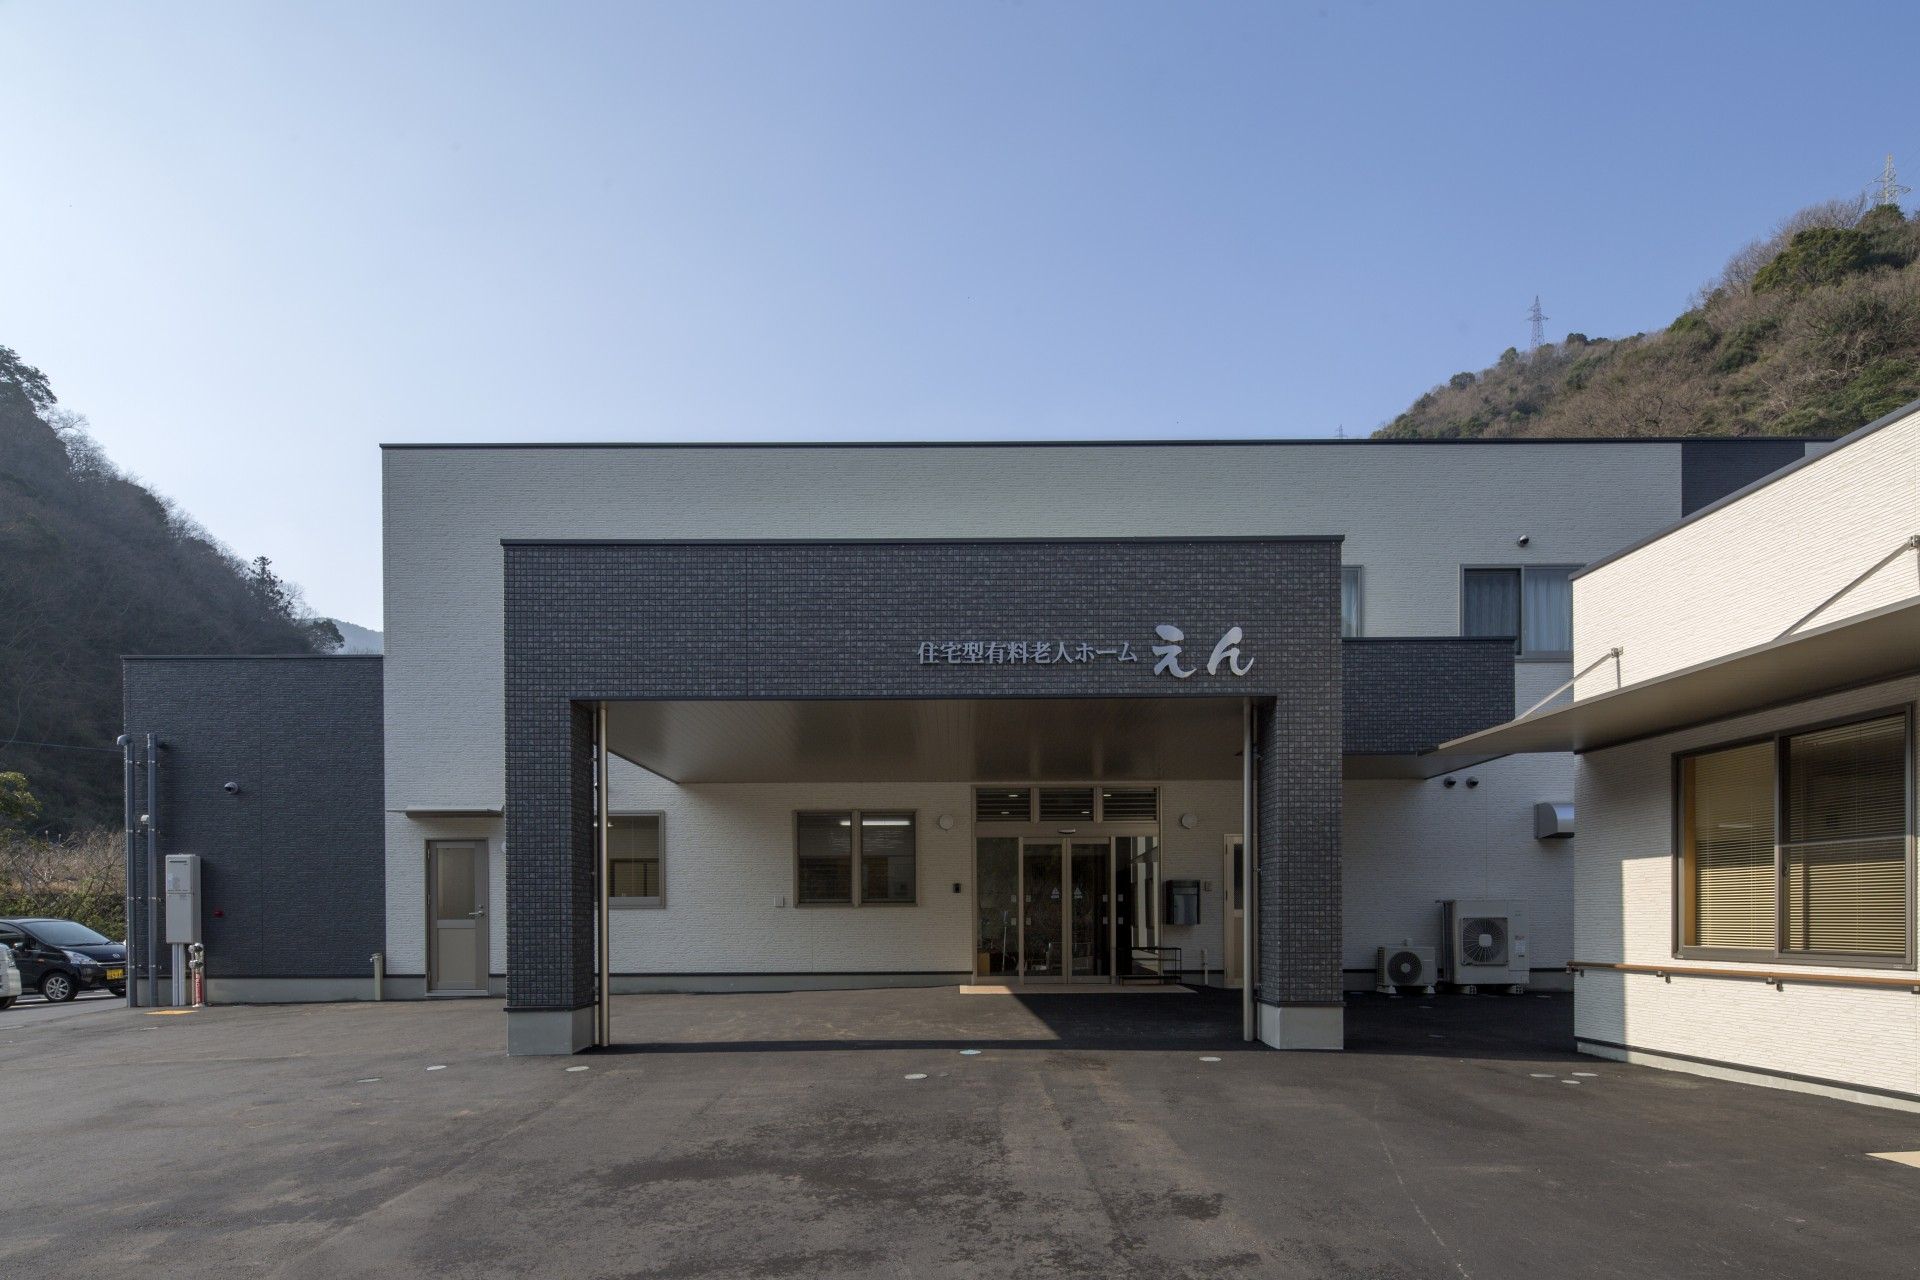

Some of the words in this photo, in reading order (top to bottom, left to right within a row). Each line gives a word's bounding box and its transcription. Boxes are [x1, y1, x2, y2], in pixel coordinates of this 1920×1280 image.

[917, 641, 1138, 665] 住宅型有料老人ホーム
[1151, 624, 1255, 678] えん
